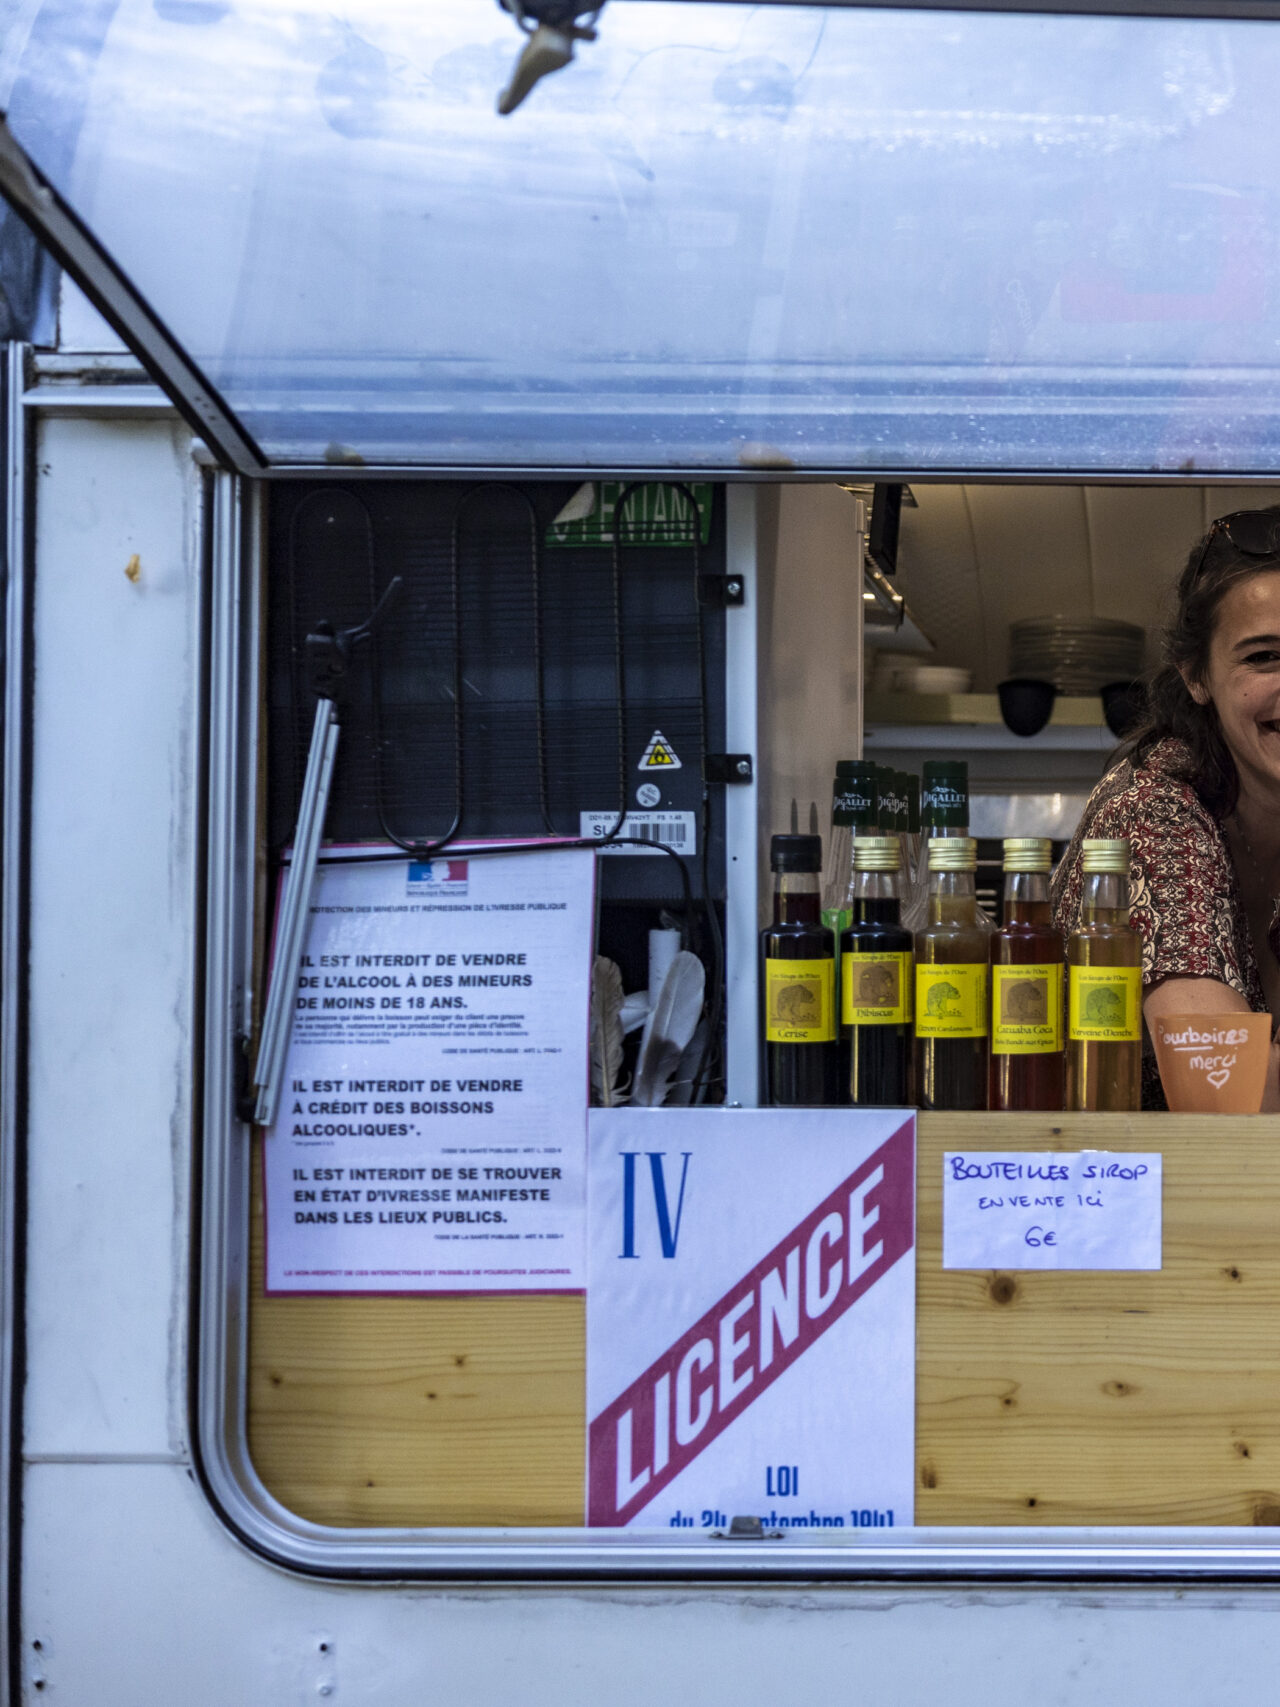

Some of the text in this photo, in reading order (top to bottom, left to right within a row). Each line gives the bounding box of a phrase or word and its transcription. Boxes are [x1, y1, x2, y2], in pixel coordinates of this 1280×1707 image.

[320, 955, 349, 968] EST
[355, 954, 431, 968] INTERDIT
[435, 954, 457, 968] DE
[462, 953, 527, 968] VENDRE
[299, 972, 533, 989] DE L'ALCOOL À DES MINEURS
[296, 997, 468, 1010] DE MOINS DE 18 ANS.
[777, 1029, 808, 1039] Cerise
[292, 1080, 523, 1092] IL EST INTERDIT DE VENDRE
[292, 1099, 494, 1114] À CRÉDIT DES BOISSONS
[292, 1168, 562, 1181] IL EST INTERDIT DE SE TROUVER
[950, 1156, 1148, 1181] BOUTEILLES SIROP
[294, 1186, 550, 1203] EN ÉTAT D'IVRESSE MANIFESTE
[617, 1152, 693, 1259] IV
[978, 1196, 1004, 1210] EN
[1008, 1195, 1065, 1208] VENTE
[294, 1211, 508, 1224] DANS LES LIEUX PUBLICS.
[1024, 1225, 1058, 1248] 6€
[615, 1162, 885, 1513] LICENCE
[766, 1465, 799, 1497] LOI
